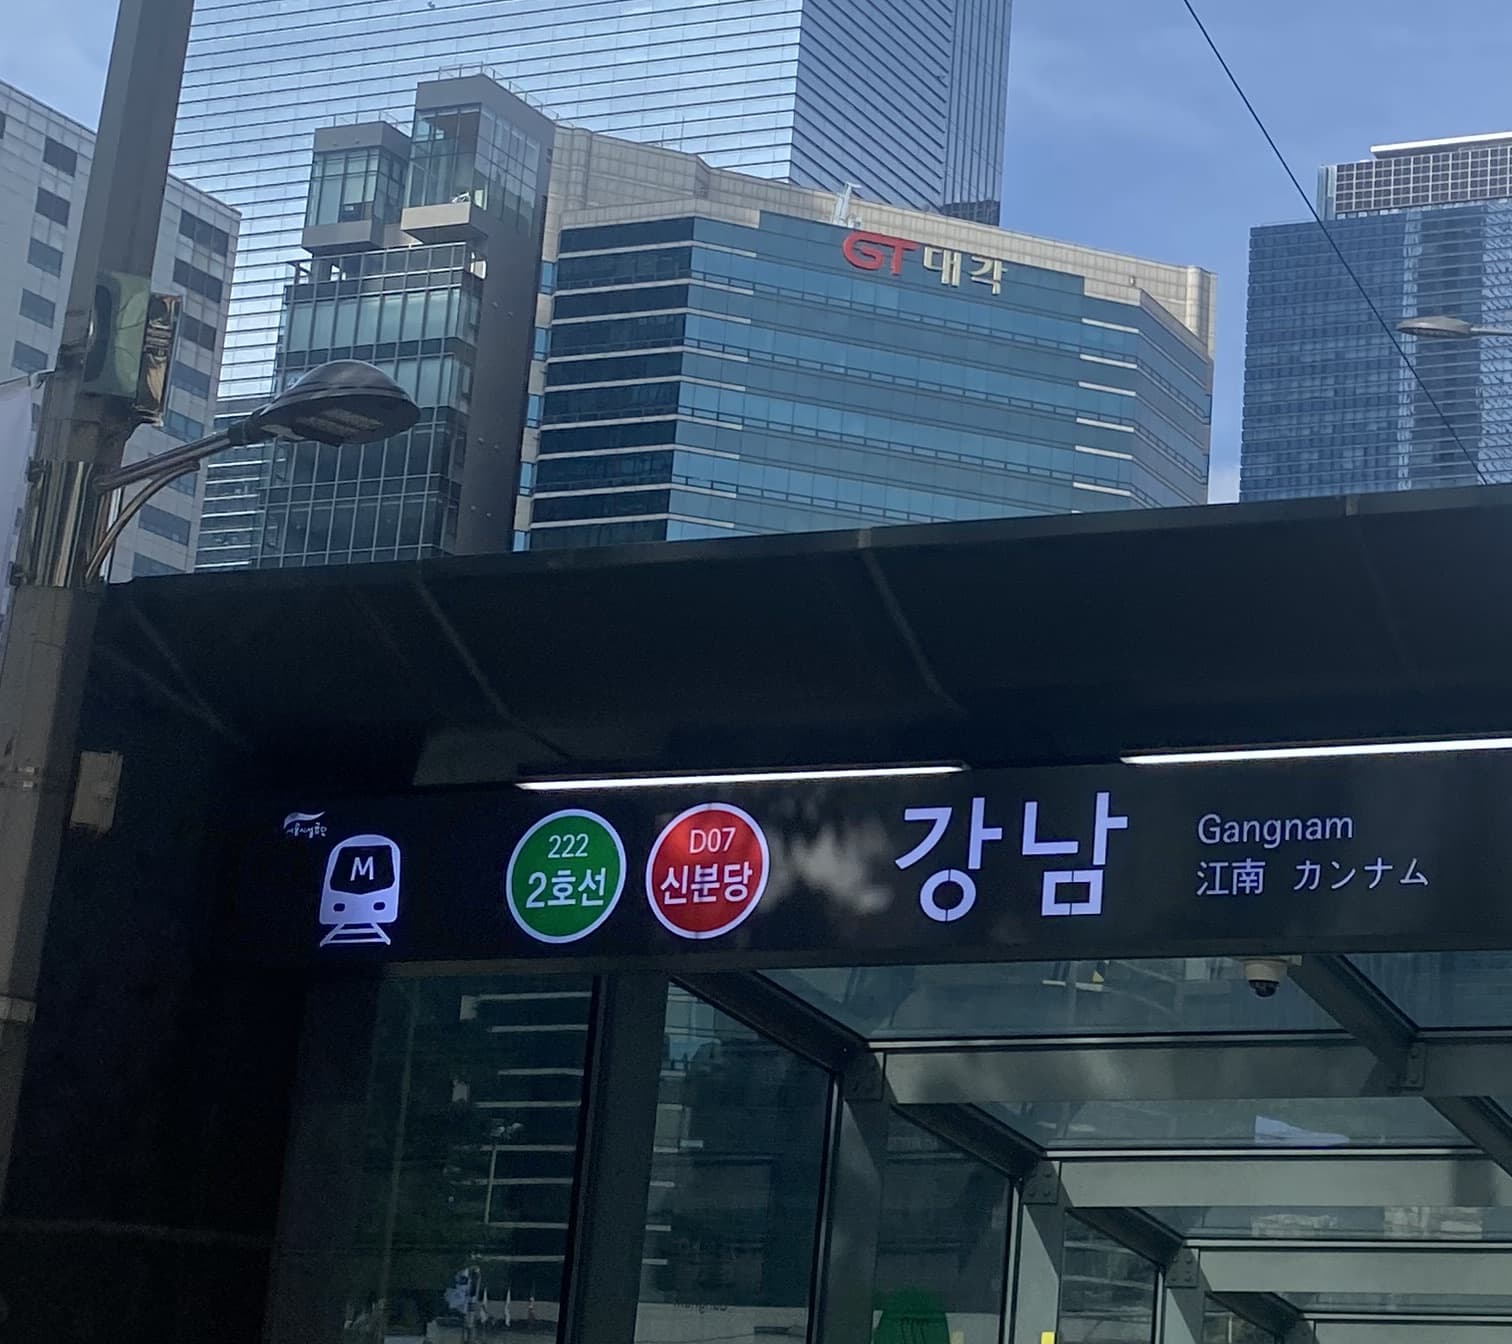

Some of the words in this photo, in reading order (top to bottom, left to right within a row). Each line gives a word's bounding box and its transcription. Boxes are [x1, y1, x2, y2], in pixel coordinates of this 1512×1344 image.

[547, 832, 590, 860] 222
[688, 826, 737, 855] D07
[1197, 813, 1354, 848] Gangnam
[349, 855, 375, 882] M
[894, 791, 1129, 923] 강남
[524, 864, 609, 911] 2호선
[657, 860, 754, 907] 신분당
[1195, 858, 1266, 897] 江南
[1292, 857, 1431, 892] カンナム
